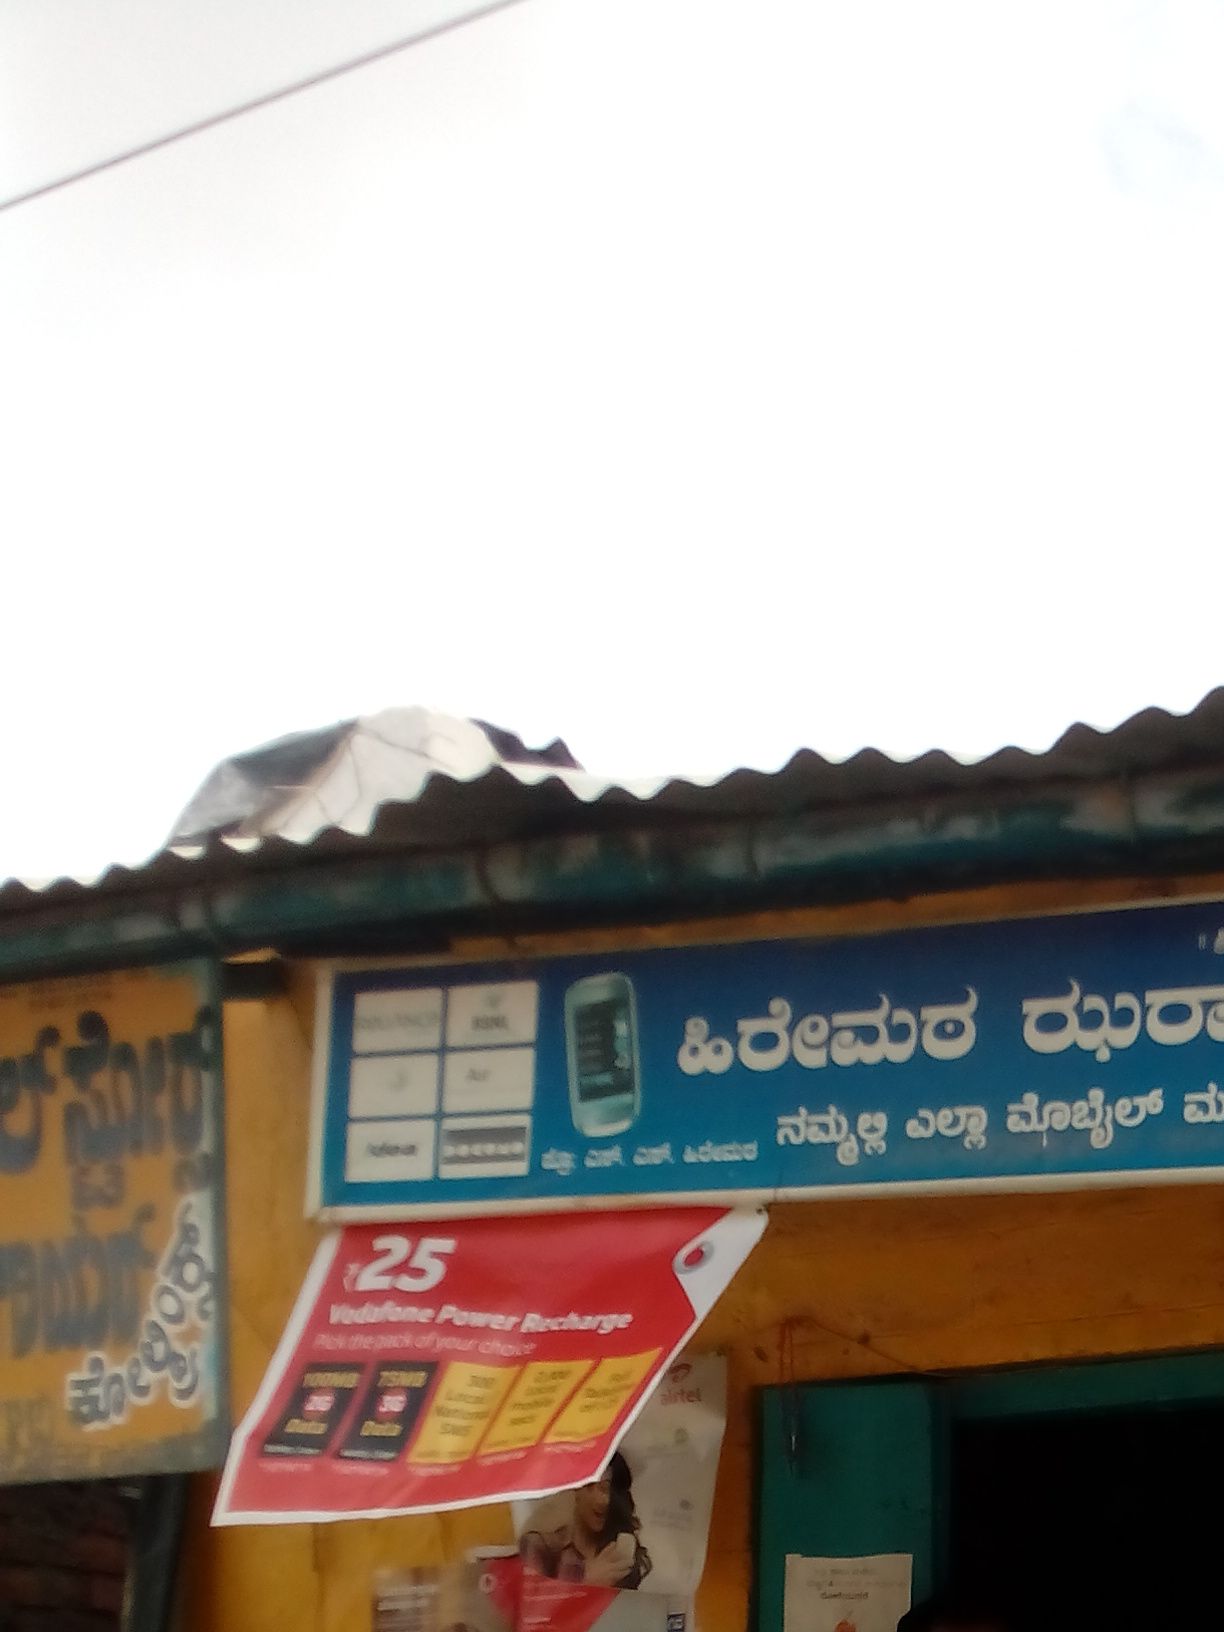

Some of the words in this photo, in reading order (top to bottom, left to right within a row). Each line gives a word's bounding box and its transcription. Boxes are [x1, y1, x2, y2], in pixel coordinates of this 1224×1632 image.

[677, 984, 977, 1076] ಹಿರೇಮಠ
[776, 1103, 888, 1167] ನಮ್ಮಲ್ಲಿ
[905, 1104, 988, 1150] ಎಲ್ಲಾ
[1006, 1086, 1164, 1149] ಮೊಬೈಲ್
[330, 1301, 435, 1325] Vodafone
[435, 1304, 519, 1331] Power
[520, 1311, 633, 1335] Recharge
